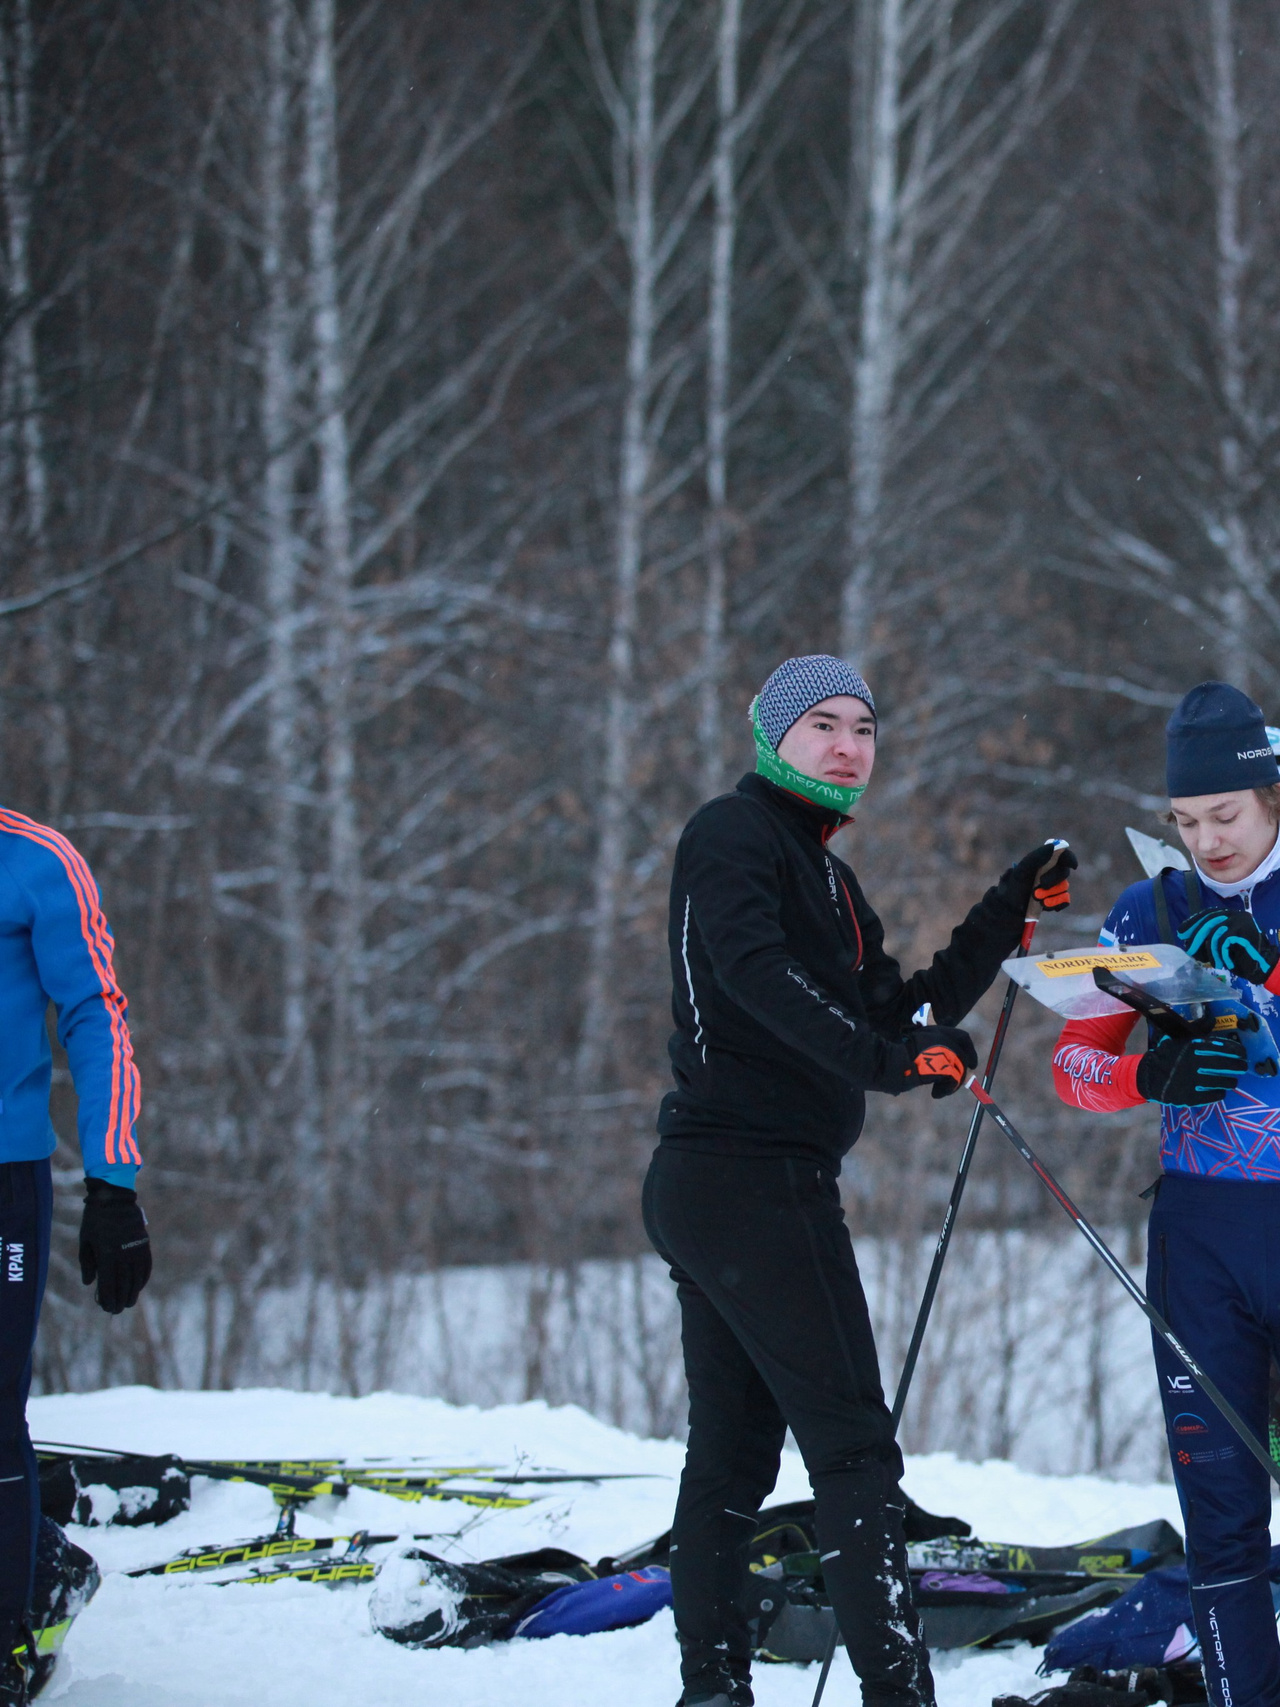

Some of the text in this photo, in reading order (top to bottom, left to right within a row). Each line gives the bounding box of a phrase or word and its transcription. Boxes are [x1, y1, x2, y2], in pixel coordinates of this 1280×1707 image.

[1044, 954, 1149, 970] NORDENMARK
[7, 1243, 24, 1282] КРАЙ
[1166, 1375, 1193, 1390] VC
[164, 1538, 317, 1574] FISCHER
[1208, 1606, 1233, 1707] VICTORY COD
